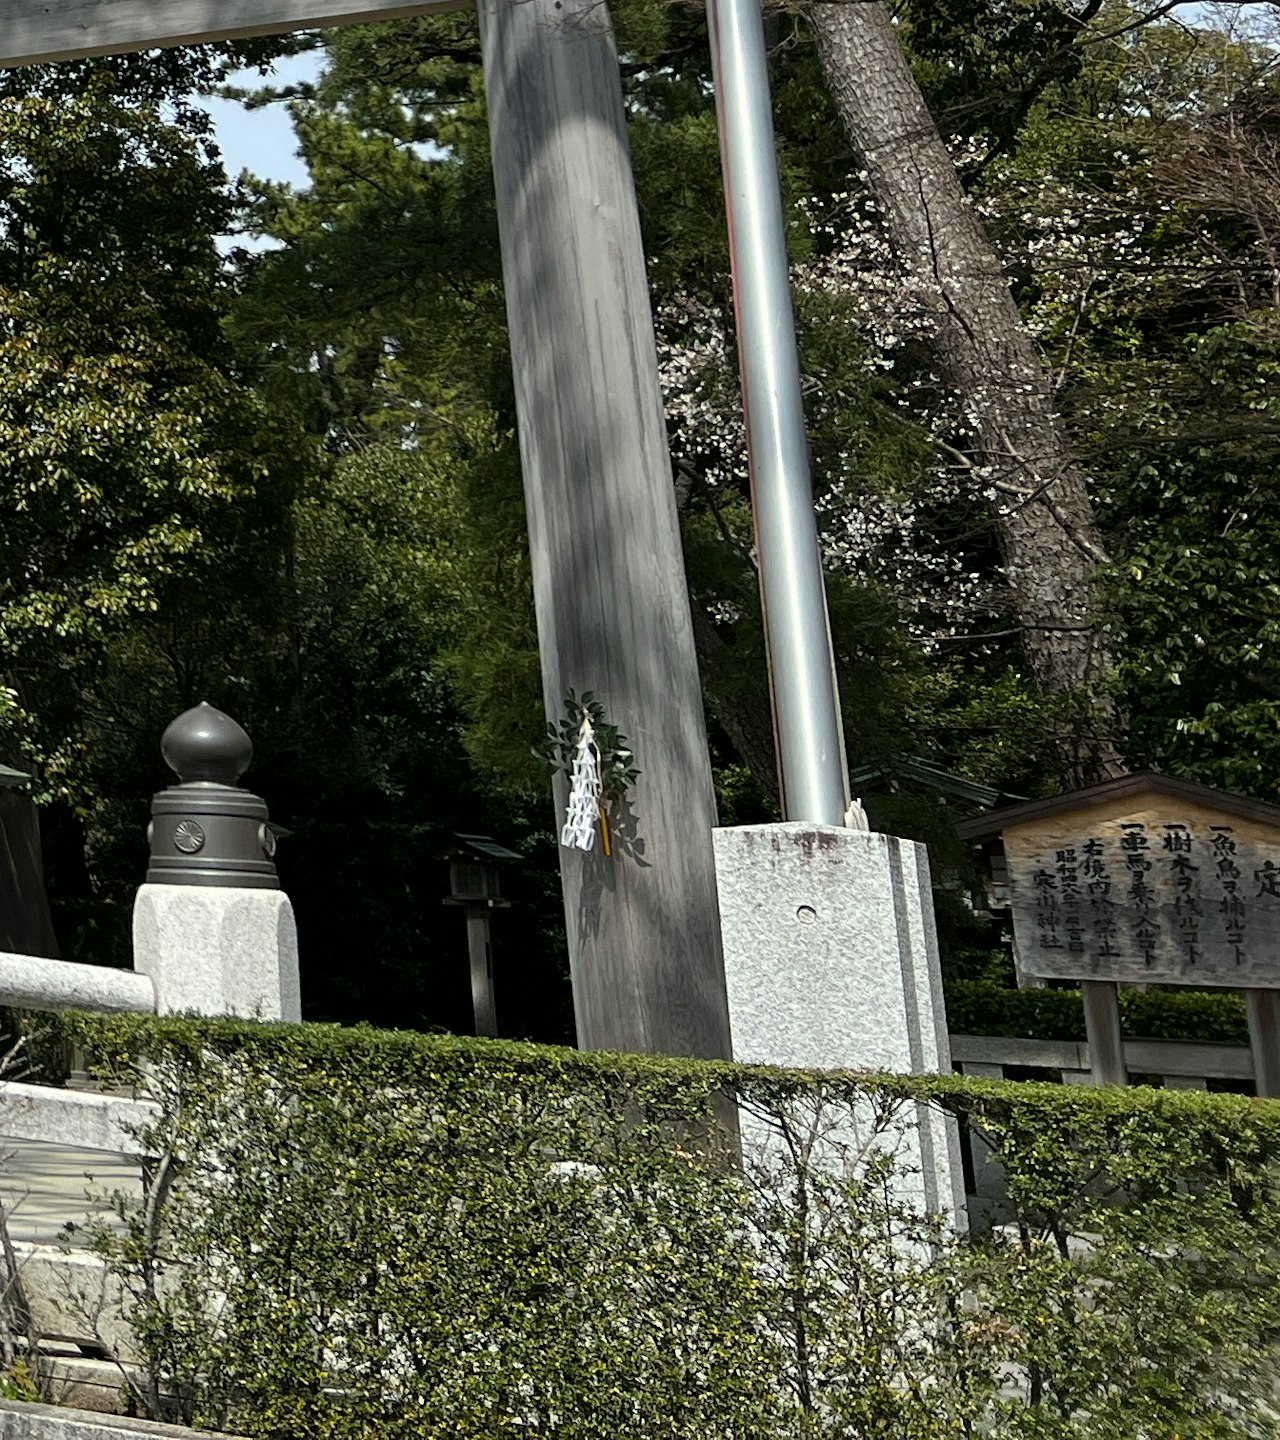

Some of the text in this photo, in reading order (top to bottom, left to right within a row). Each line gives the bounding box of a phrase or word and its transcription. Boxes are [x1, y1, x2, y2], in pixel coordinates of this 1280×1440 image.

[1254, 860, 1280, 898] 定
[1033, 869, 1064, 949] 寒川神社
